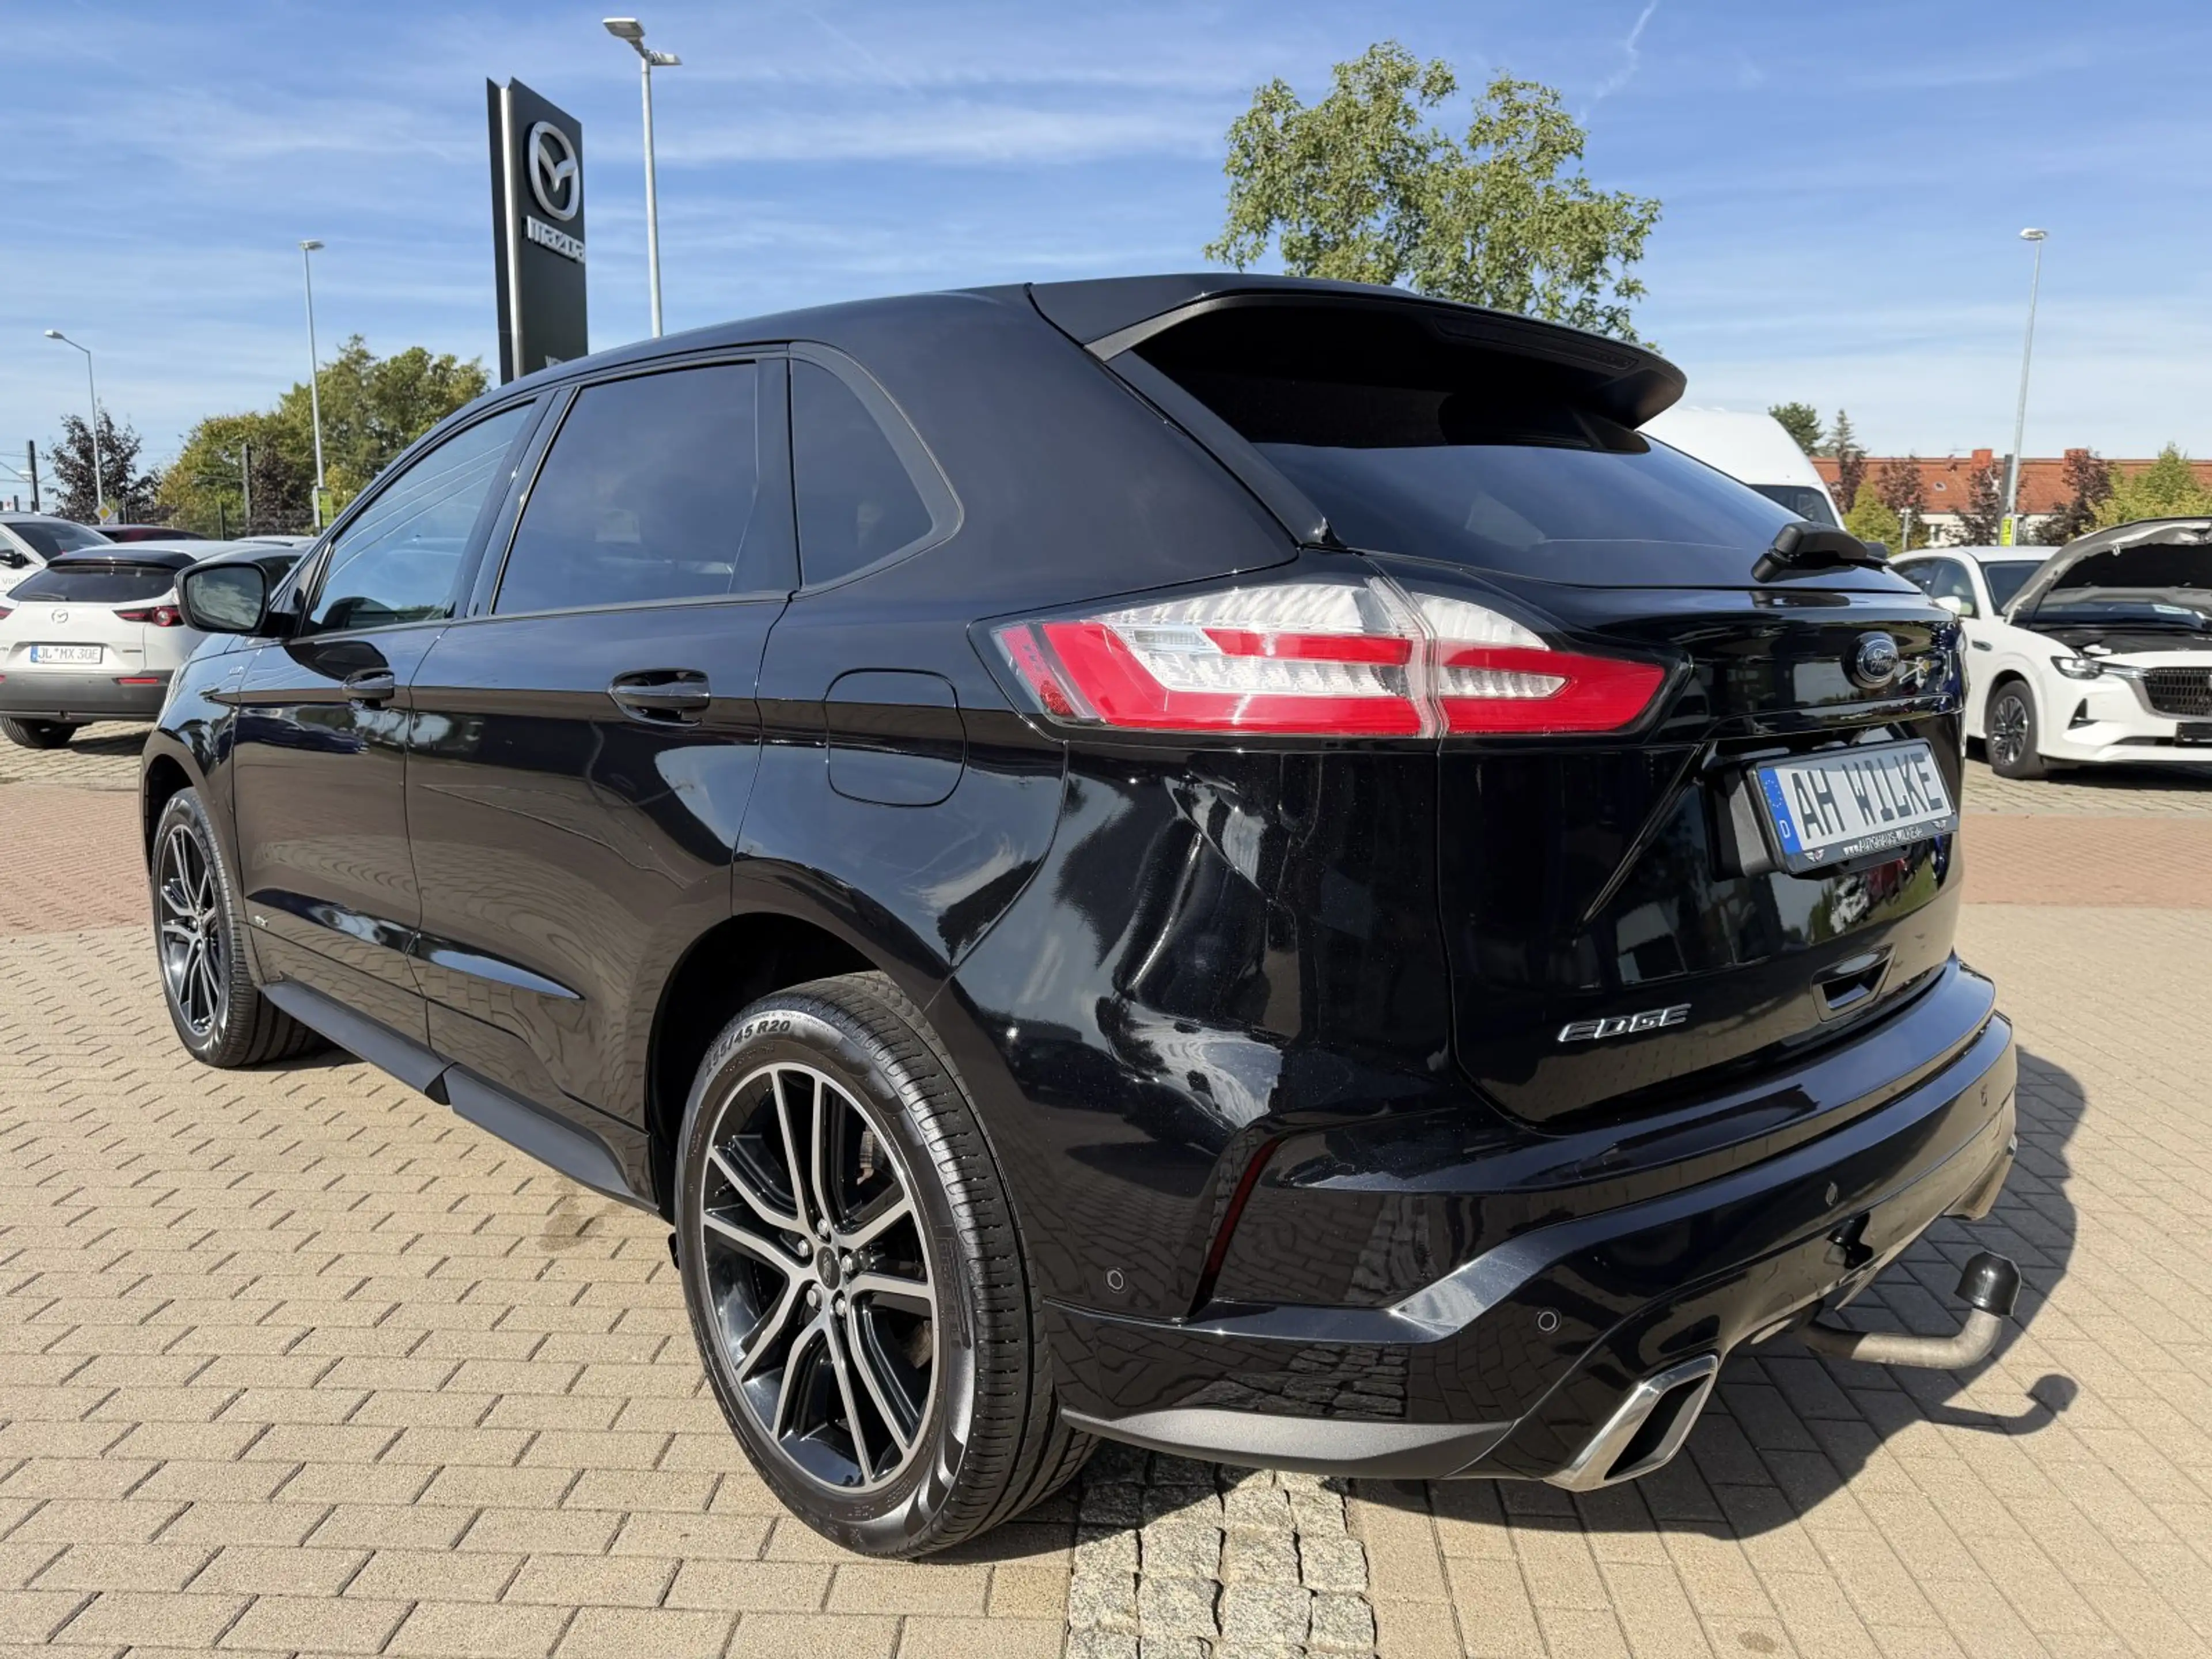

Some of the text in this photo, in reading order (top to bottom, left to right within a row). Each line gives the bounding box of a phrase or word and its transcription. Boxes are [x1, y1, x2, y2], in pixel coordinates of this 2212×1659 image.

[39, 647, 52, 658] JL
[59, 648, 74, 660] MX
[1790, 752, 1944, 839] AH WILKE
[1779, 820, 1790, 839] D
[756, 1020, 791, 1035] R20
[1557, 1003, 1692, 1042] EDGE
